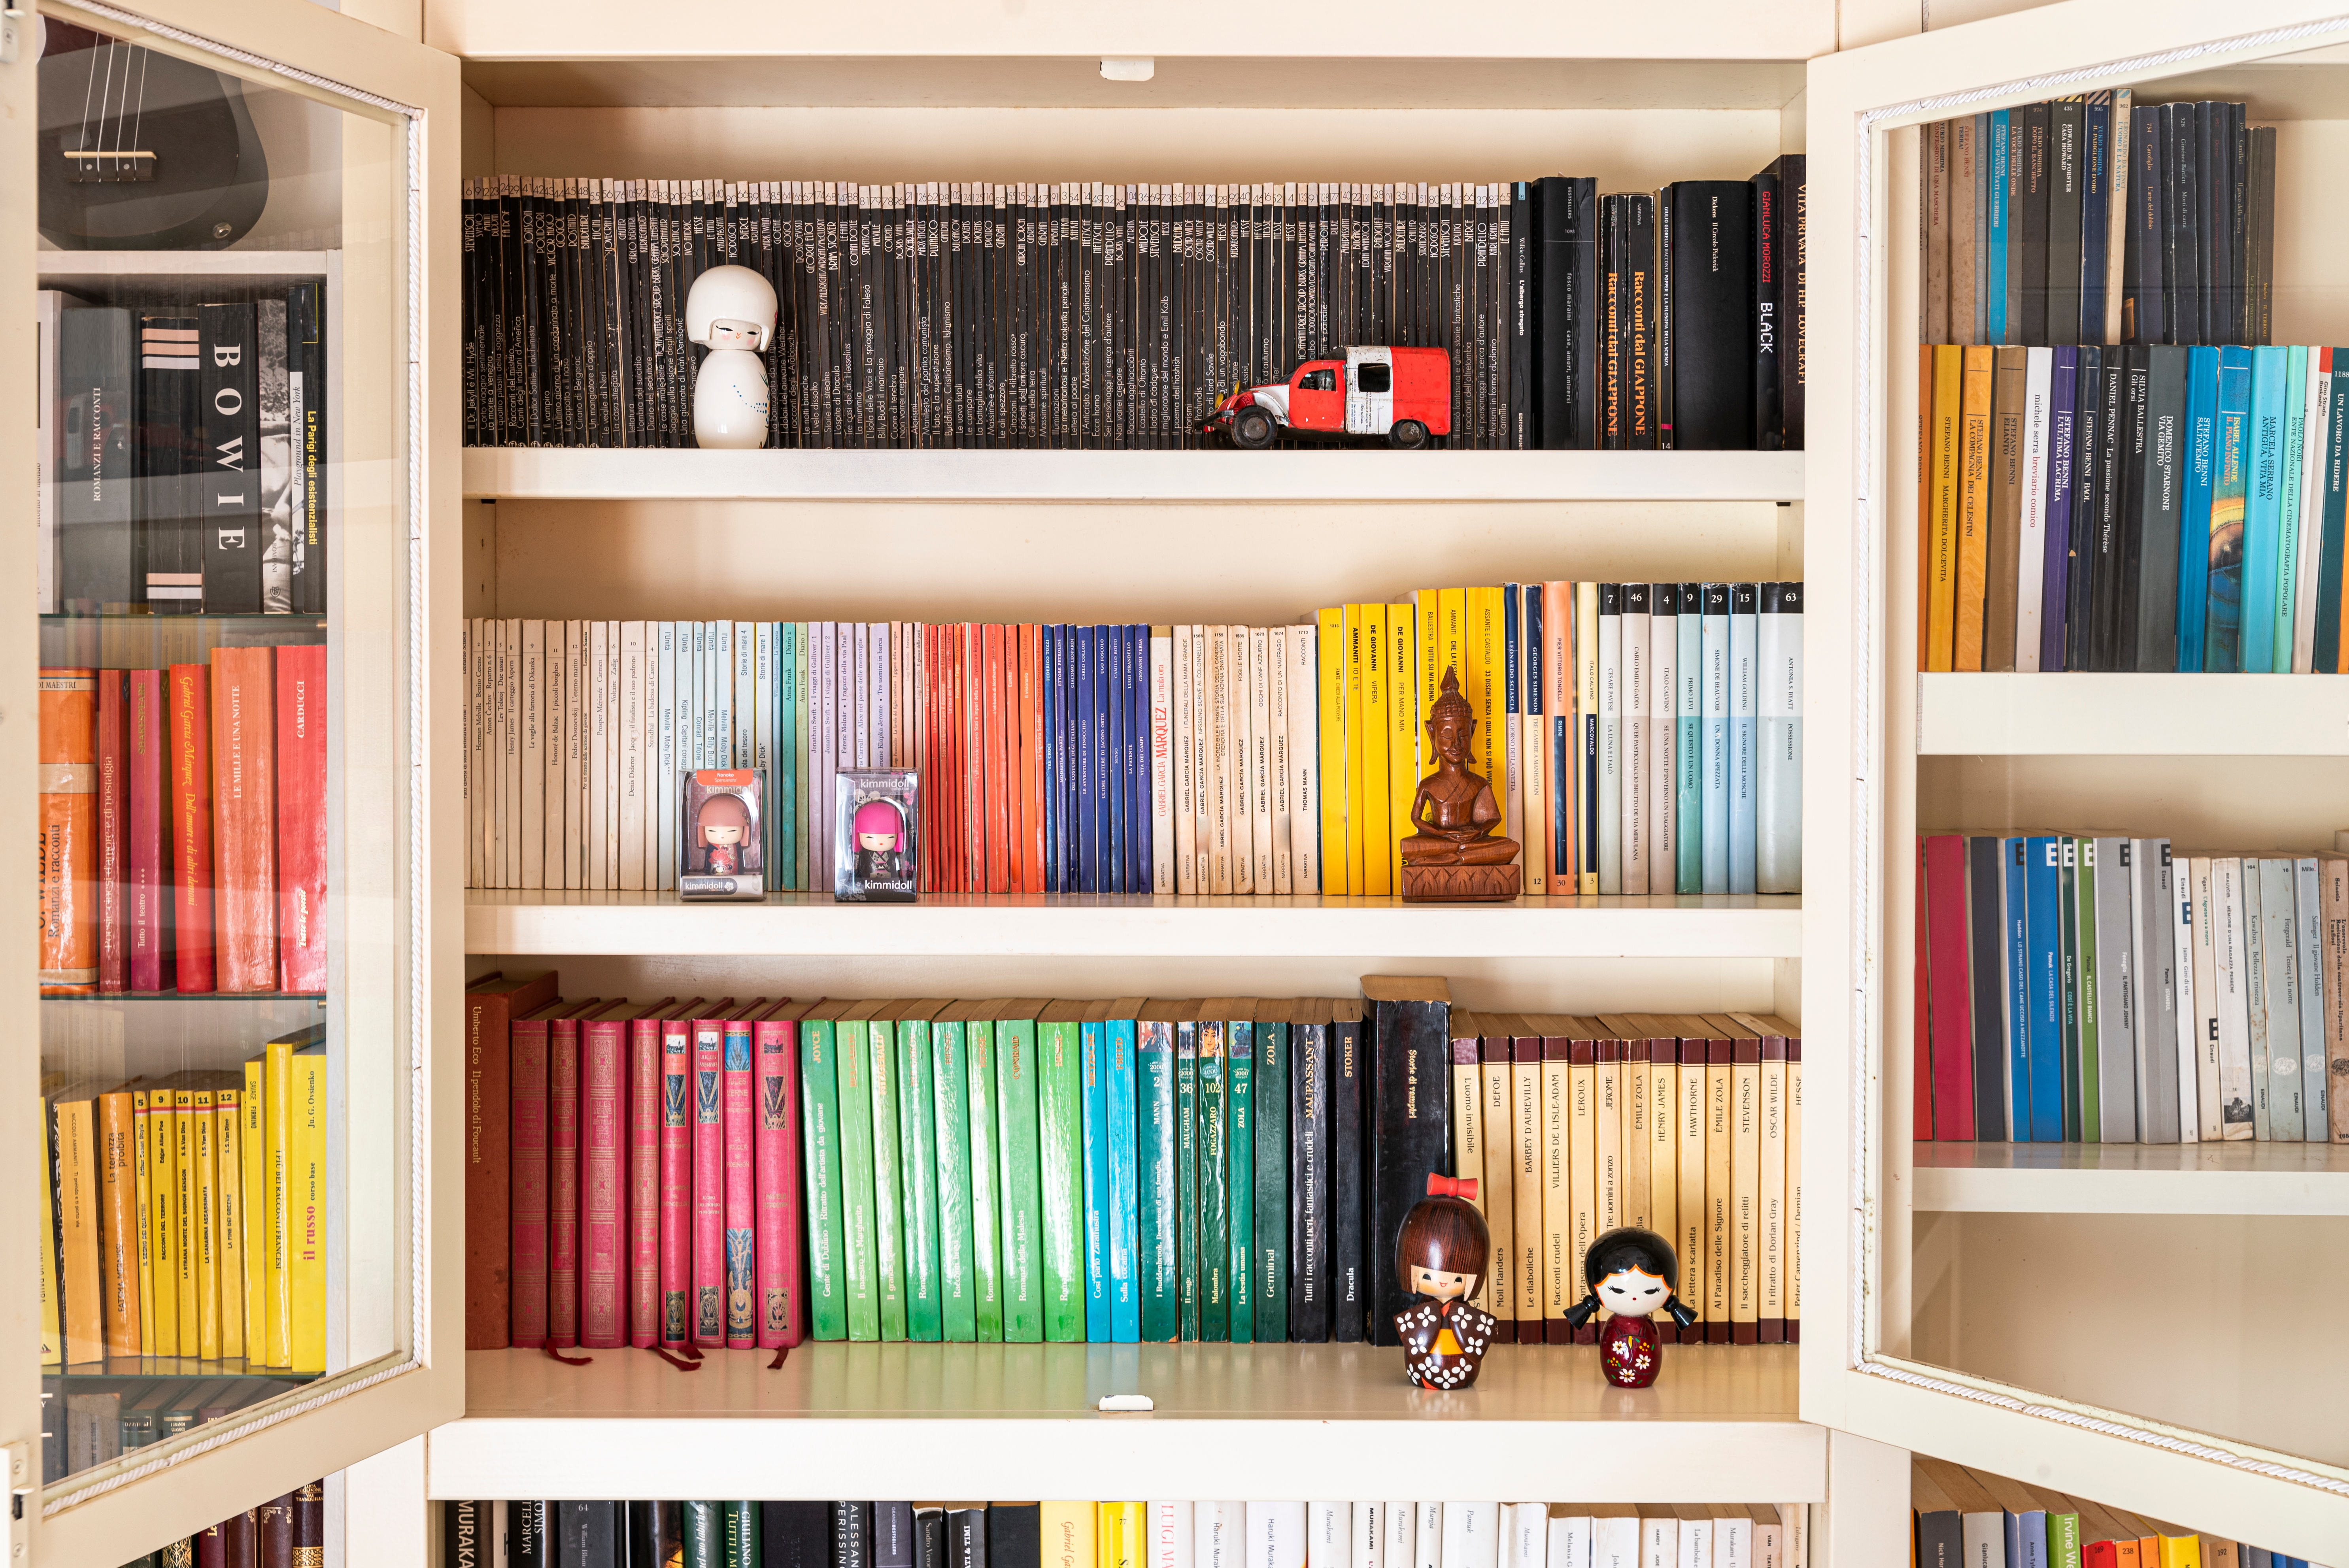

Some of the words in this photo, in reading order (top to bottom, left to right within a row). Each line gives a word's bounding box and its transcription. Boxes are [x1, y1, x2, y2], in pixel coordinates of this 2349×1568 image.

[1207, 222, 1216, 239] WILDE
[1286, 223, 1295, 241] HESSE
[1206, 240, 1214, 262] OSCAR
[1634, 272, 1645, 331] Racconti
[1760, 303, 1773, 353] BLACK
[1635, 334, 1645, 356] dal
[574, 356, 583, 390] Bergerac
[1635, 359, 1645, 436] GIAPPONE
[2033, 394, 2042, 428] michele
[2337, 394, 2344, 406] UN
[308, 411, 316, 423] La
[211, 343, 244, 551] BOWIE
[306, 425, 316, 452] Parigi
[2165, 416, 2173, 463] DOMENICO
[2334, 445, 2341, 457] DA
[306, 455, 317, 478] degli
[2031, 457, 2040, 496] breviario
[2162, 465, 2171, 511] STARNONE
[306, 481, 317, 545] esistenzialisti
[2030, 499, 2038, 528] comico
[1741, 594, 1750, 602] 15
[1786, 593, 1796, 602] 63
[1397, 627, 1403, 636] DE
[179, 677, 194, 709] Gabriel
[1157, 694, 1165, 702] La
[296, 680, 306, 738] CARDUCCI
[179, 710, 194, 739] García
[1156, 707, 1167, 759] MÁRQUEZ
[181, 741, 195, 786] Márquez
[1157, 761, 1166, 786] GARCÍA
[1688, 760, 1693, 769] UN
[48, 824, 60, 872] racconti
[865, 879, 912, 890] kimmidoll
[48, 885, 60, 938] Romanzi
[2310, 916, 2319, 939] Salinger
[472, 1047, 481, 1064] Eco
[1343, 1036, 1354, 1077] STOKER
[1408, 1050, 1417, 1074] Storie
[1408, 1076, 1417, 1085] di
[471, 1079, 481, 1113] pendolo
[1407, 1086, 1416, 1119] vampiri
[248, 1106, 258, 1128] FIRMINO
[473, 1115, 481, 1124] di
[473, 1126, 481, 1164] Foucault
[1466, 1114, 1474, 1154] invisibile
[307, 1206, 315, 1244] russo
[303, 1250, 315, 1260] il
[1265, 1249, 1276, 1297] Germinal
[2062, 1517, 2075, 1549] Irvine
